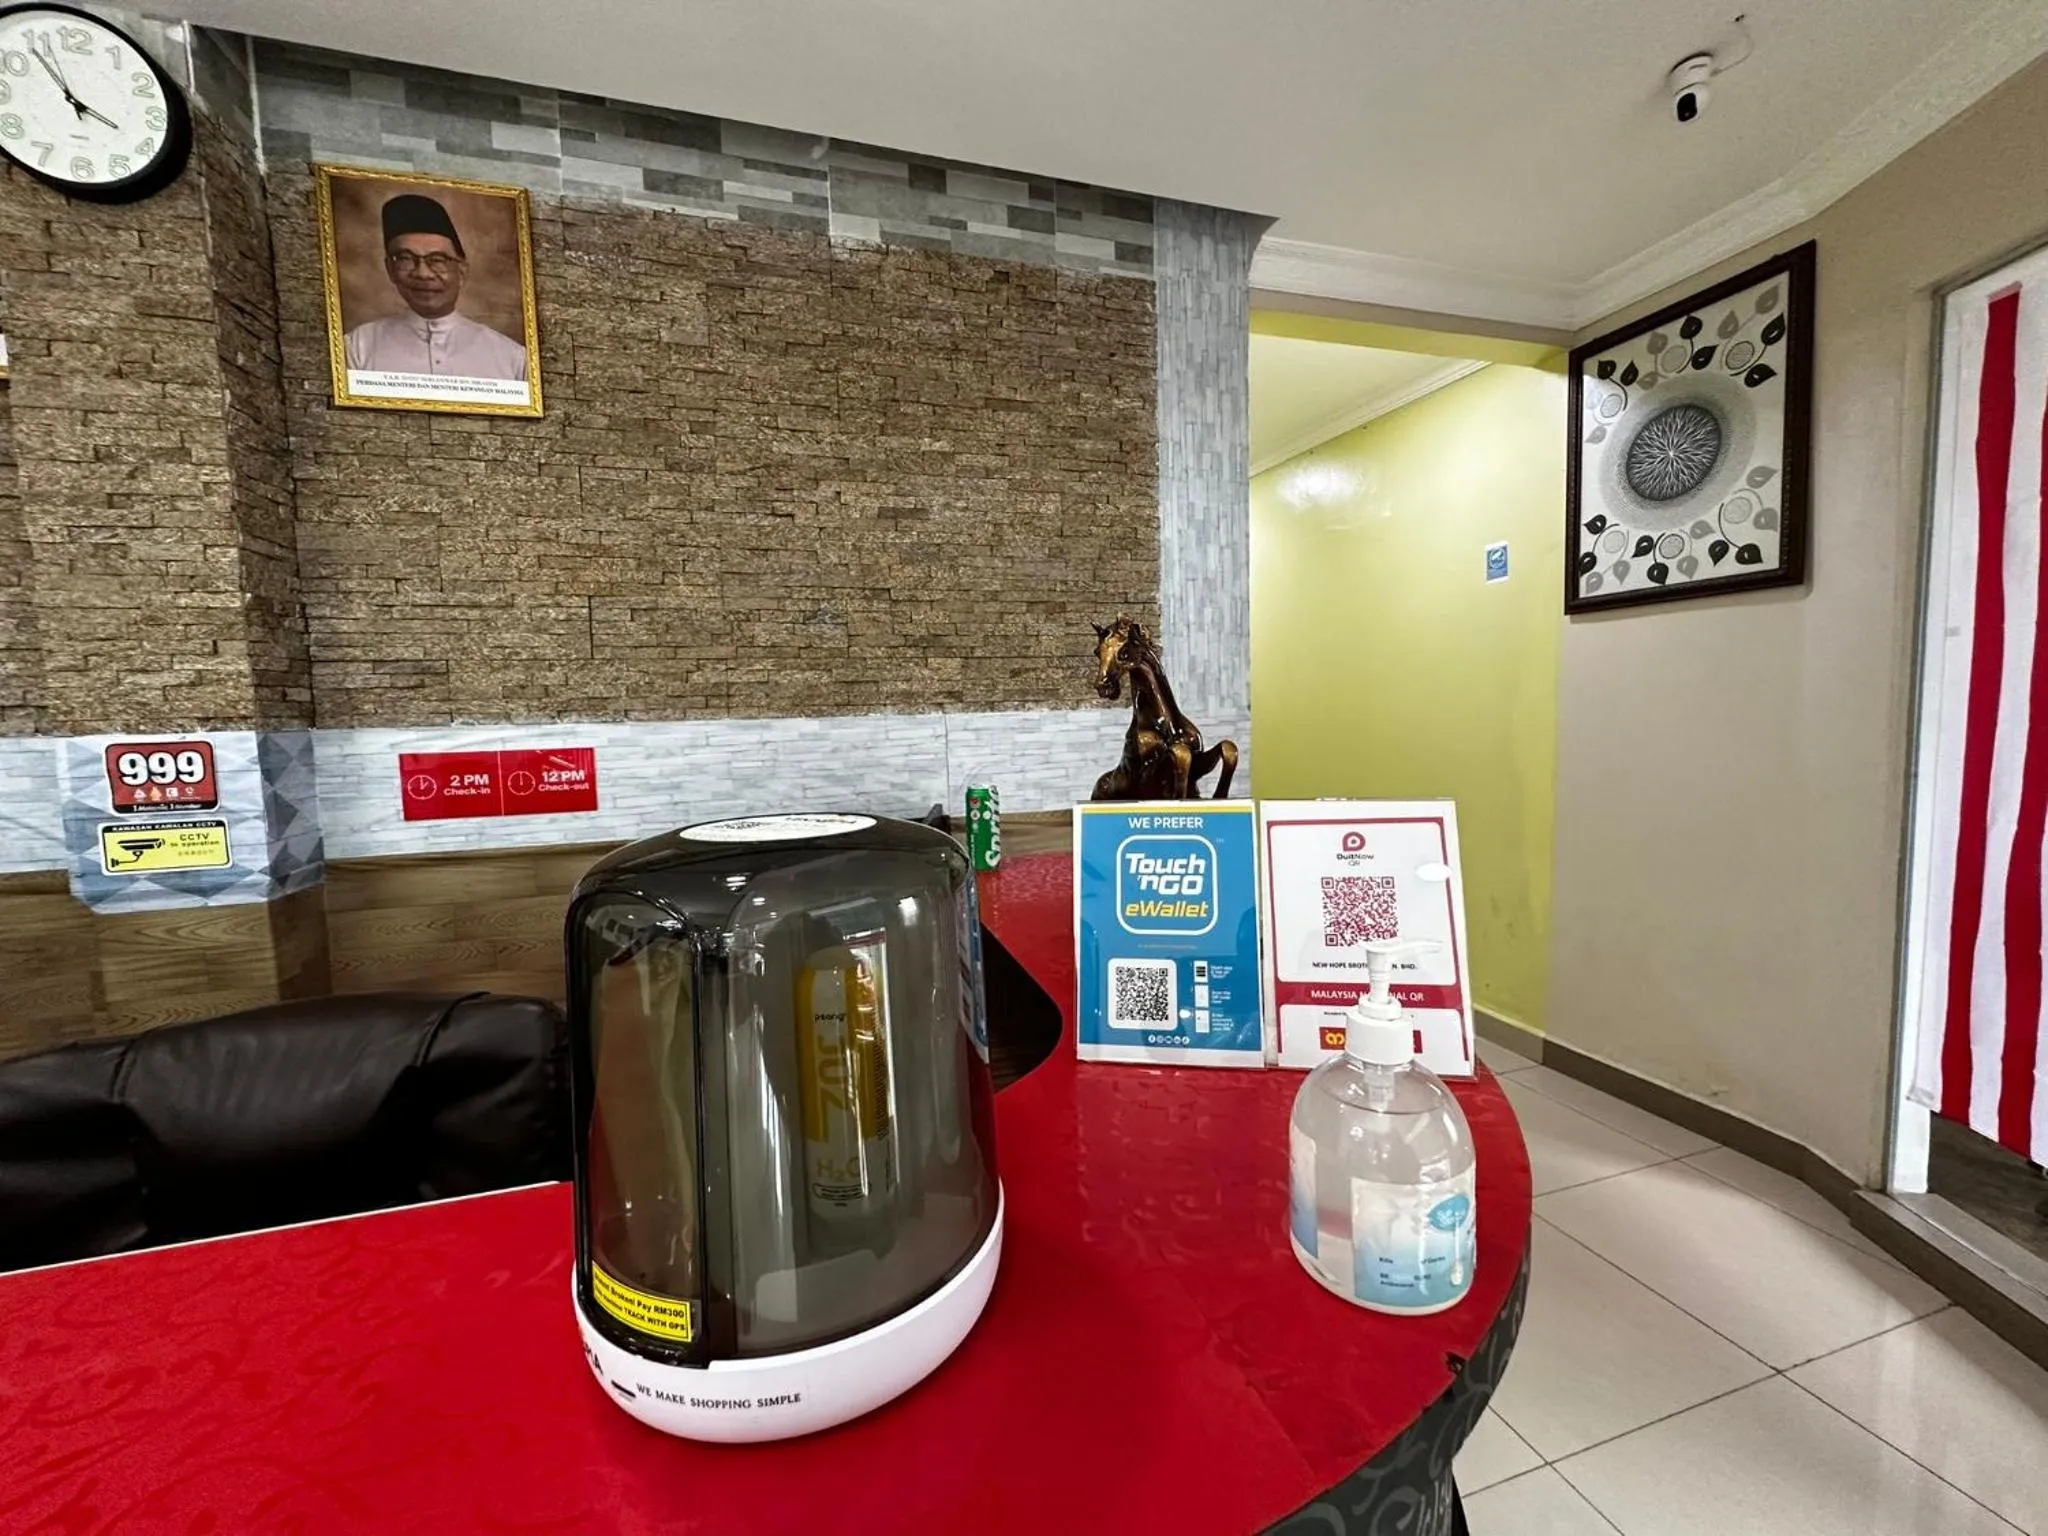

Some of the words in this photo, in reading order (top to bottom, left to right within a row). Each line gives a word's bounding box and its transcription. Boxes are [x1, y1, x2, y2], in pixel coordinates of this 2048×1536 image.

[22, 28, 51, 57] 11
[56, 25, 94, 56] 12
[105, 45, 121, 70] 1
[131, 71, 156, 99] 2
[0, 112, 26, 140] 8
[145, 105, 168, 132] 3
[31, 140, 54, 167] 7
[134, 137, 156, 158] 4
[70, 156, 95, 181] 6
[108, 153, 132, 178] 5
[117, 750, 206, 786] 999
[542, 771, 560, 783] 12
[560, 769, 586, 783] PM
[450, 775, 461, 787] 2
[464, 773, 490, 787] PM
[538, 782, 590, 793] Check-out
[443, 787, 491, 797] Check-in
[1127, 816, 1152, 830] WE
[1153, 816, 1205, 830] PREFER
[179, 832, 211, 842] CCTV
[1124, 852, 1207, 875] Touch
[1124, 900, 1210, 919] eWallet
[1329, 961, 1347, 969] HOPE
[1310, 989, 1359, 999] MALAYSIA
[1408, 991, 1425, 1002] QR
[637, 1299, 652, 1313] Pay
[623, 1307, 646, 1321] TRACK
[646, 1316, 667, 1328] WITH
[668, 1321, 686, 1331] GPS
[635, 1381, 652, 1398] WE
[655, 1388, 686, 1405] MAKE
[690, 1396, 752, 1410] SHOPPING
[756, 1392, 802, 1408] SIMPLE
